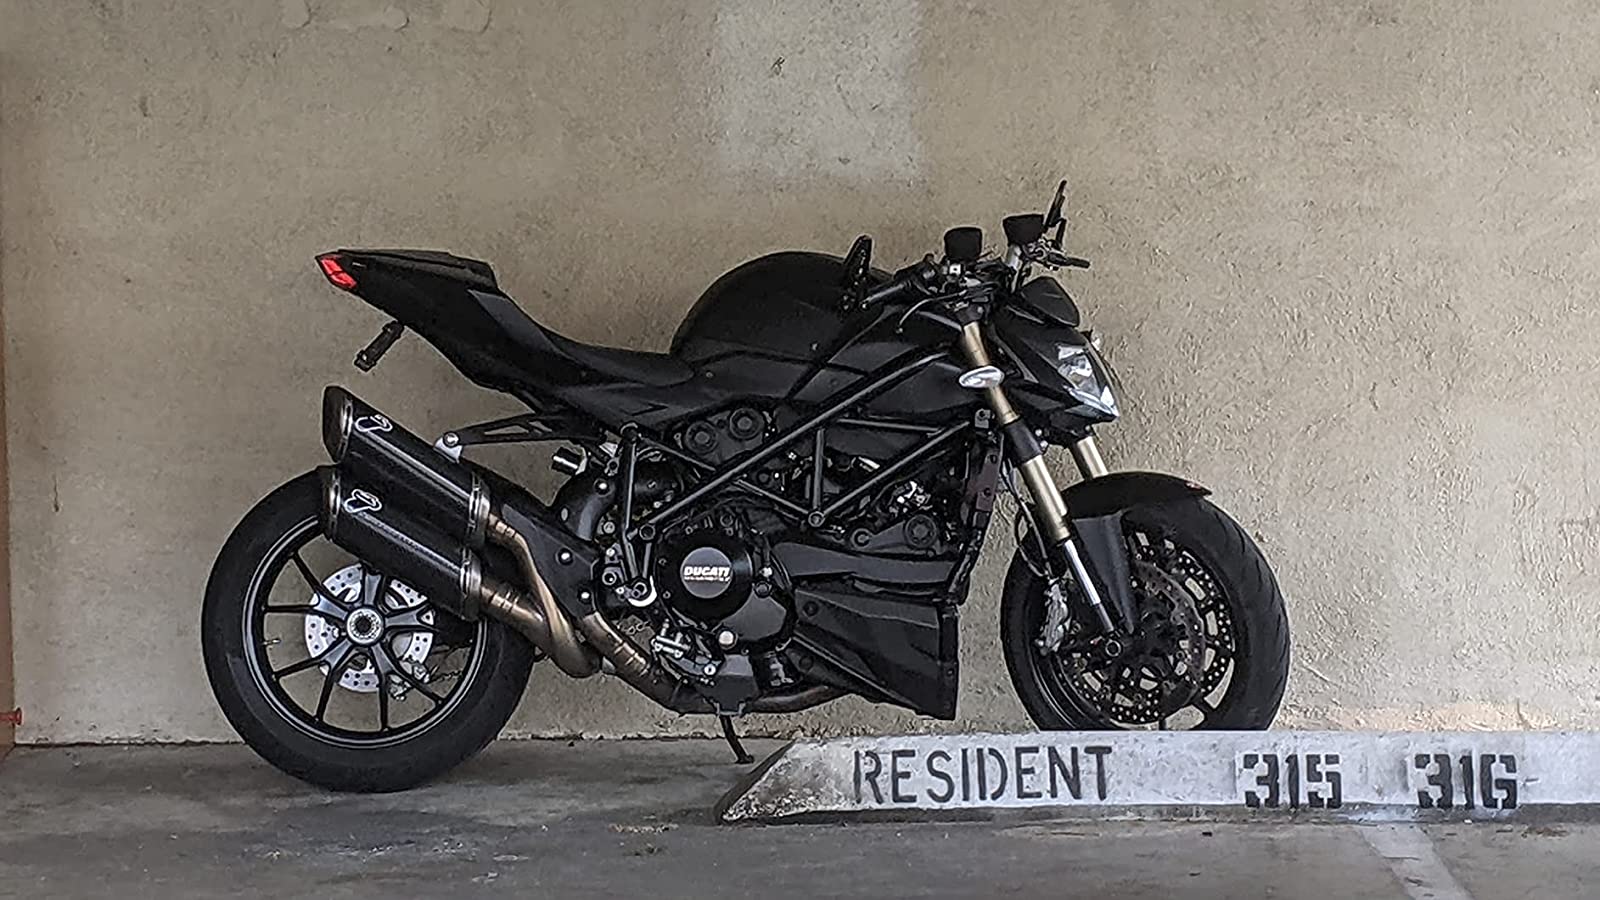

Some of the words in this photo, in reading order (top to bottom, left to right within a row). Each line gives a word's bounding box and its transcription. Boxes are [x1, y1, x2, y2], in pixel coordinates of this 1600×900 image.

[684, 566, 730, 577] DUCATI
[853, 746, 1112, 804] RESIDENT
[1243, 754, 1342, 809] 315
[1415, 754, 1517, 809] 316
